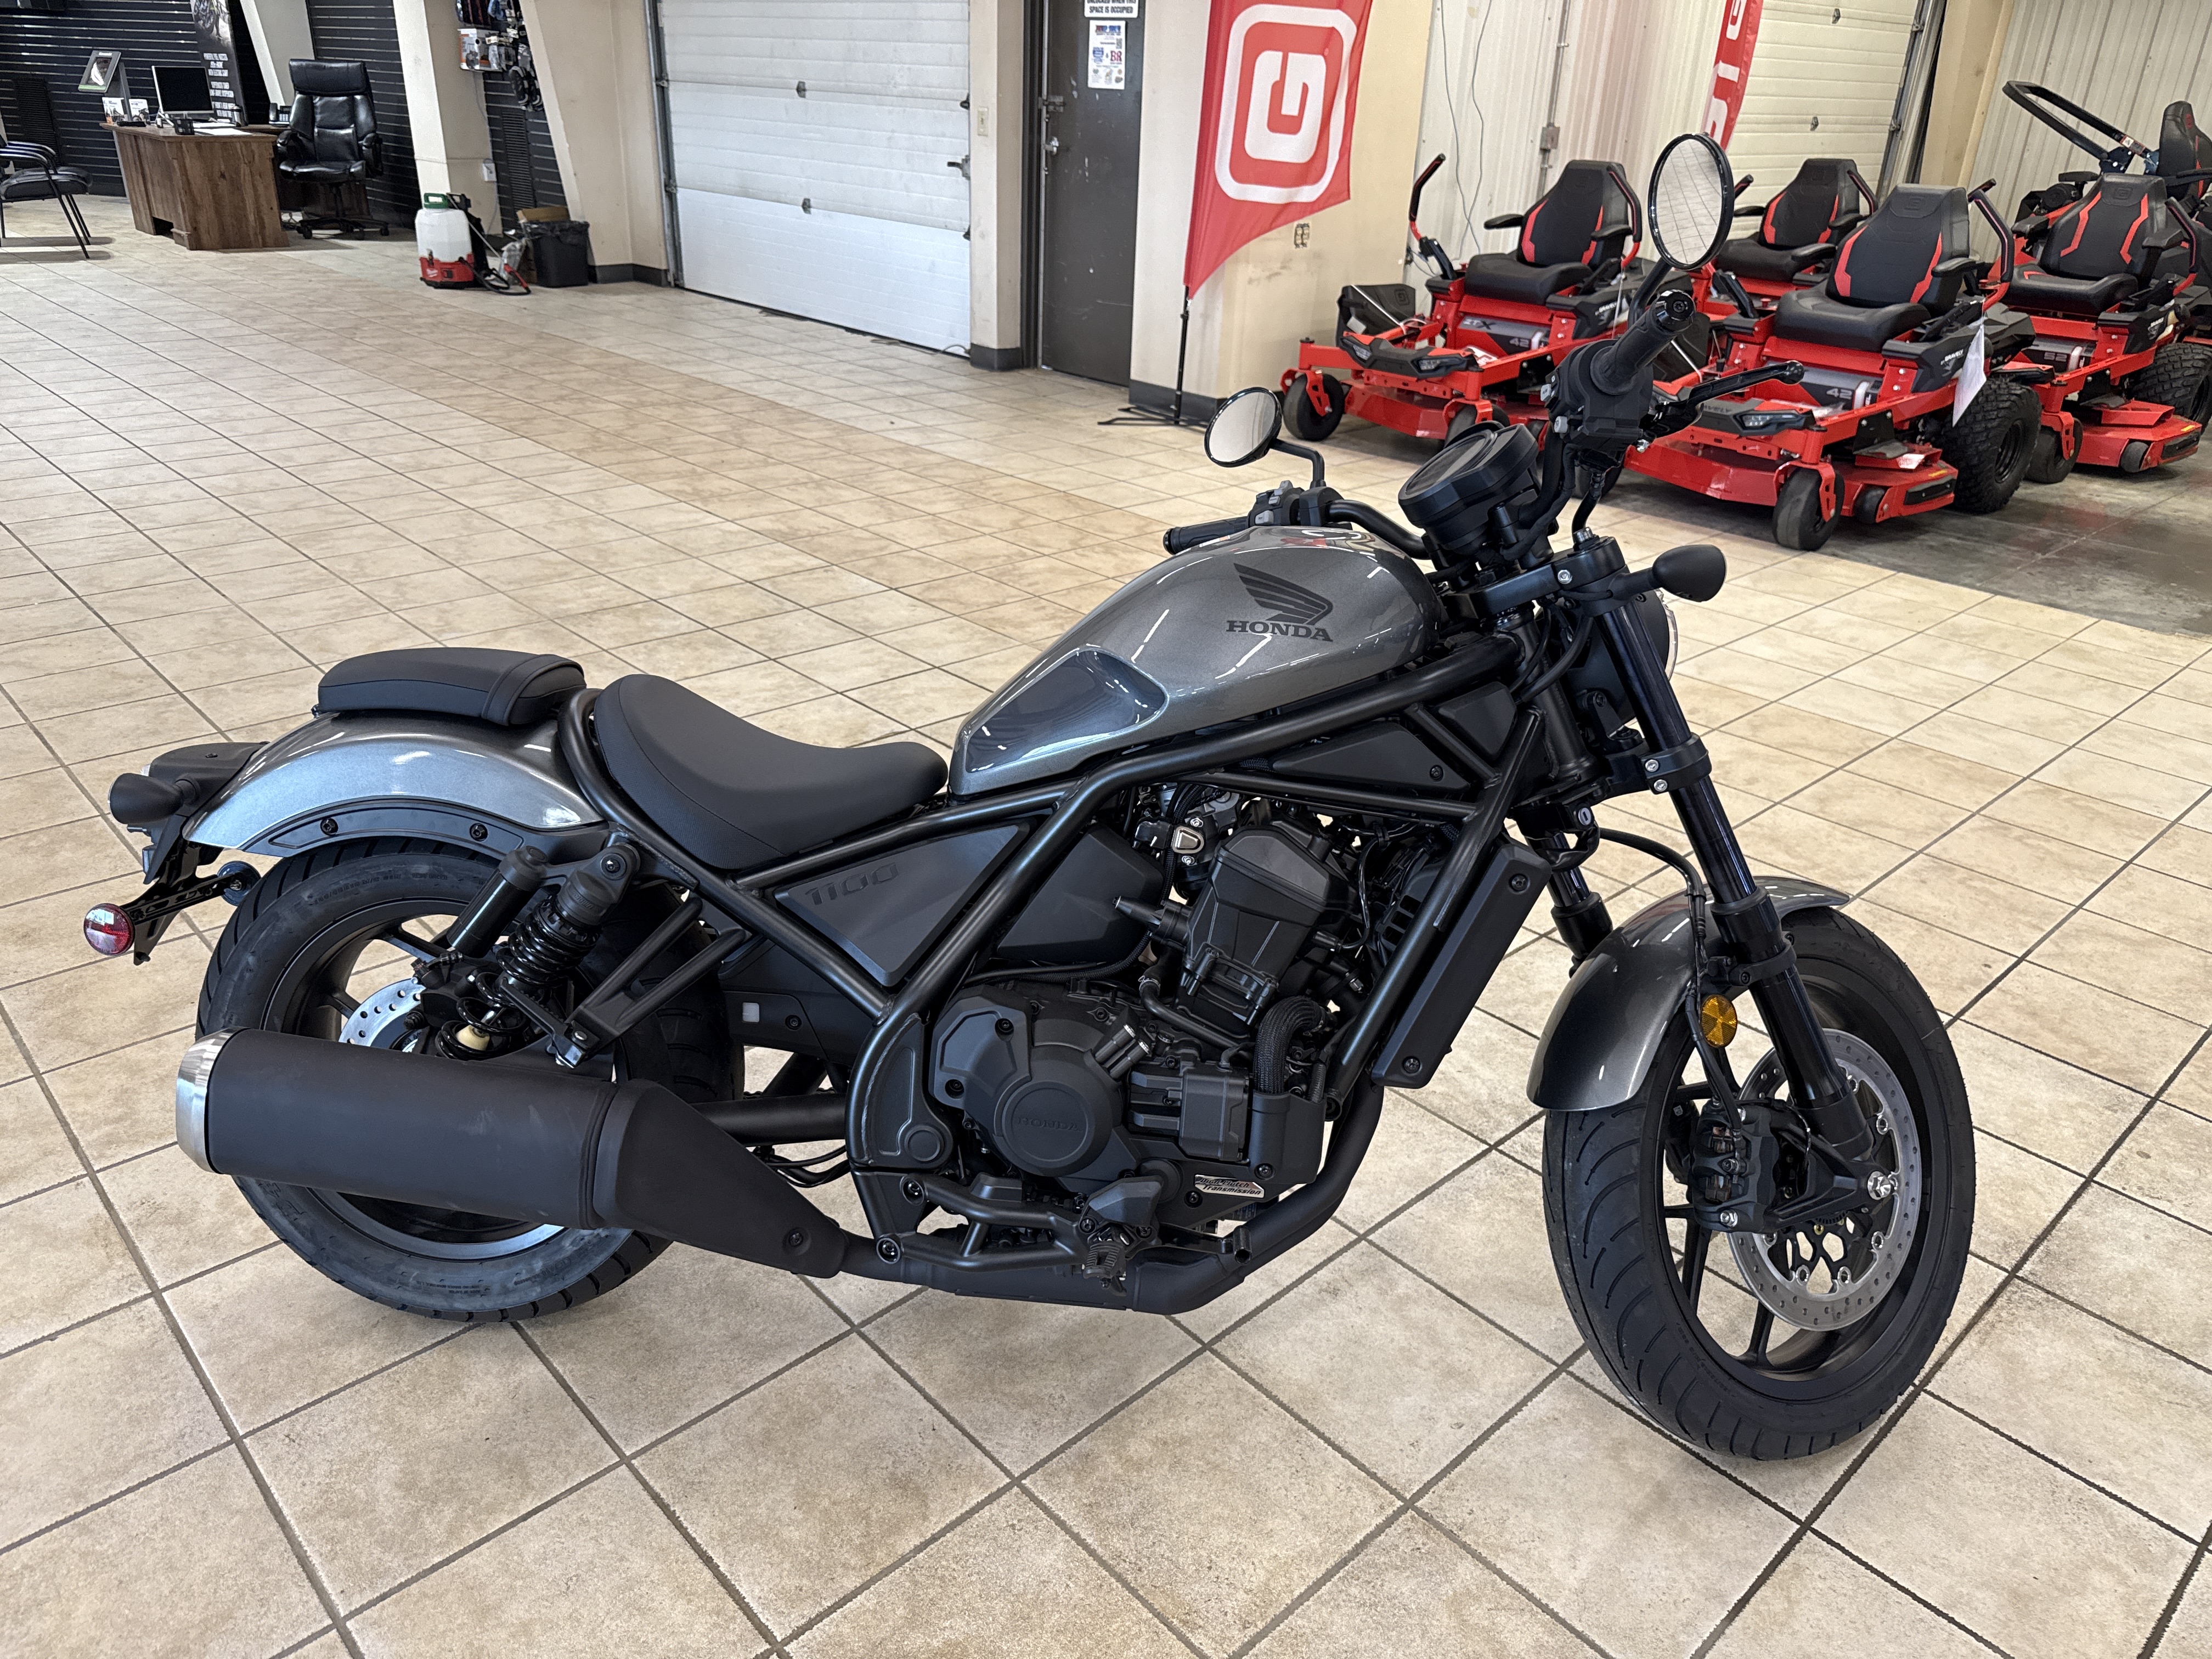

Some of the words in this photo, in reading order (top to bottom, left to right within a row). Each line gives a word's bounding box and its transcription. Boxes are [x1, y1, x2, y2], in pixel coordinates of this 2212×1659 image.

[1509, 337, 1529, 348] 42
[2044, 352, 2068, 362] 52
[1826, 388, 1853, 400] 42
[1226, 620, 1334, 642] HONDA
[804, 862, 900, 906] 1100
[1018, 1116, 1084, 1133] HONDA
[1222, 1179, 1250, 1188] Clutch
[1202, 1184, 1261, 1195] Transmission
